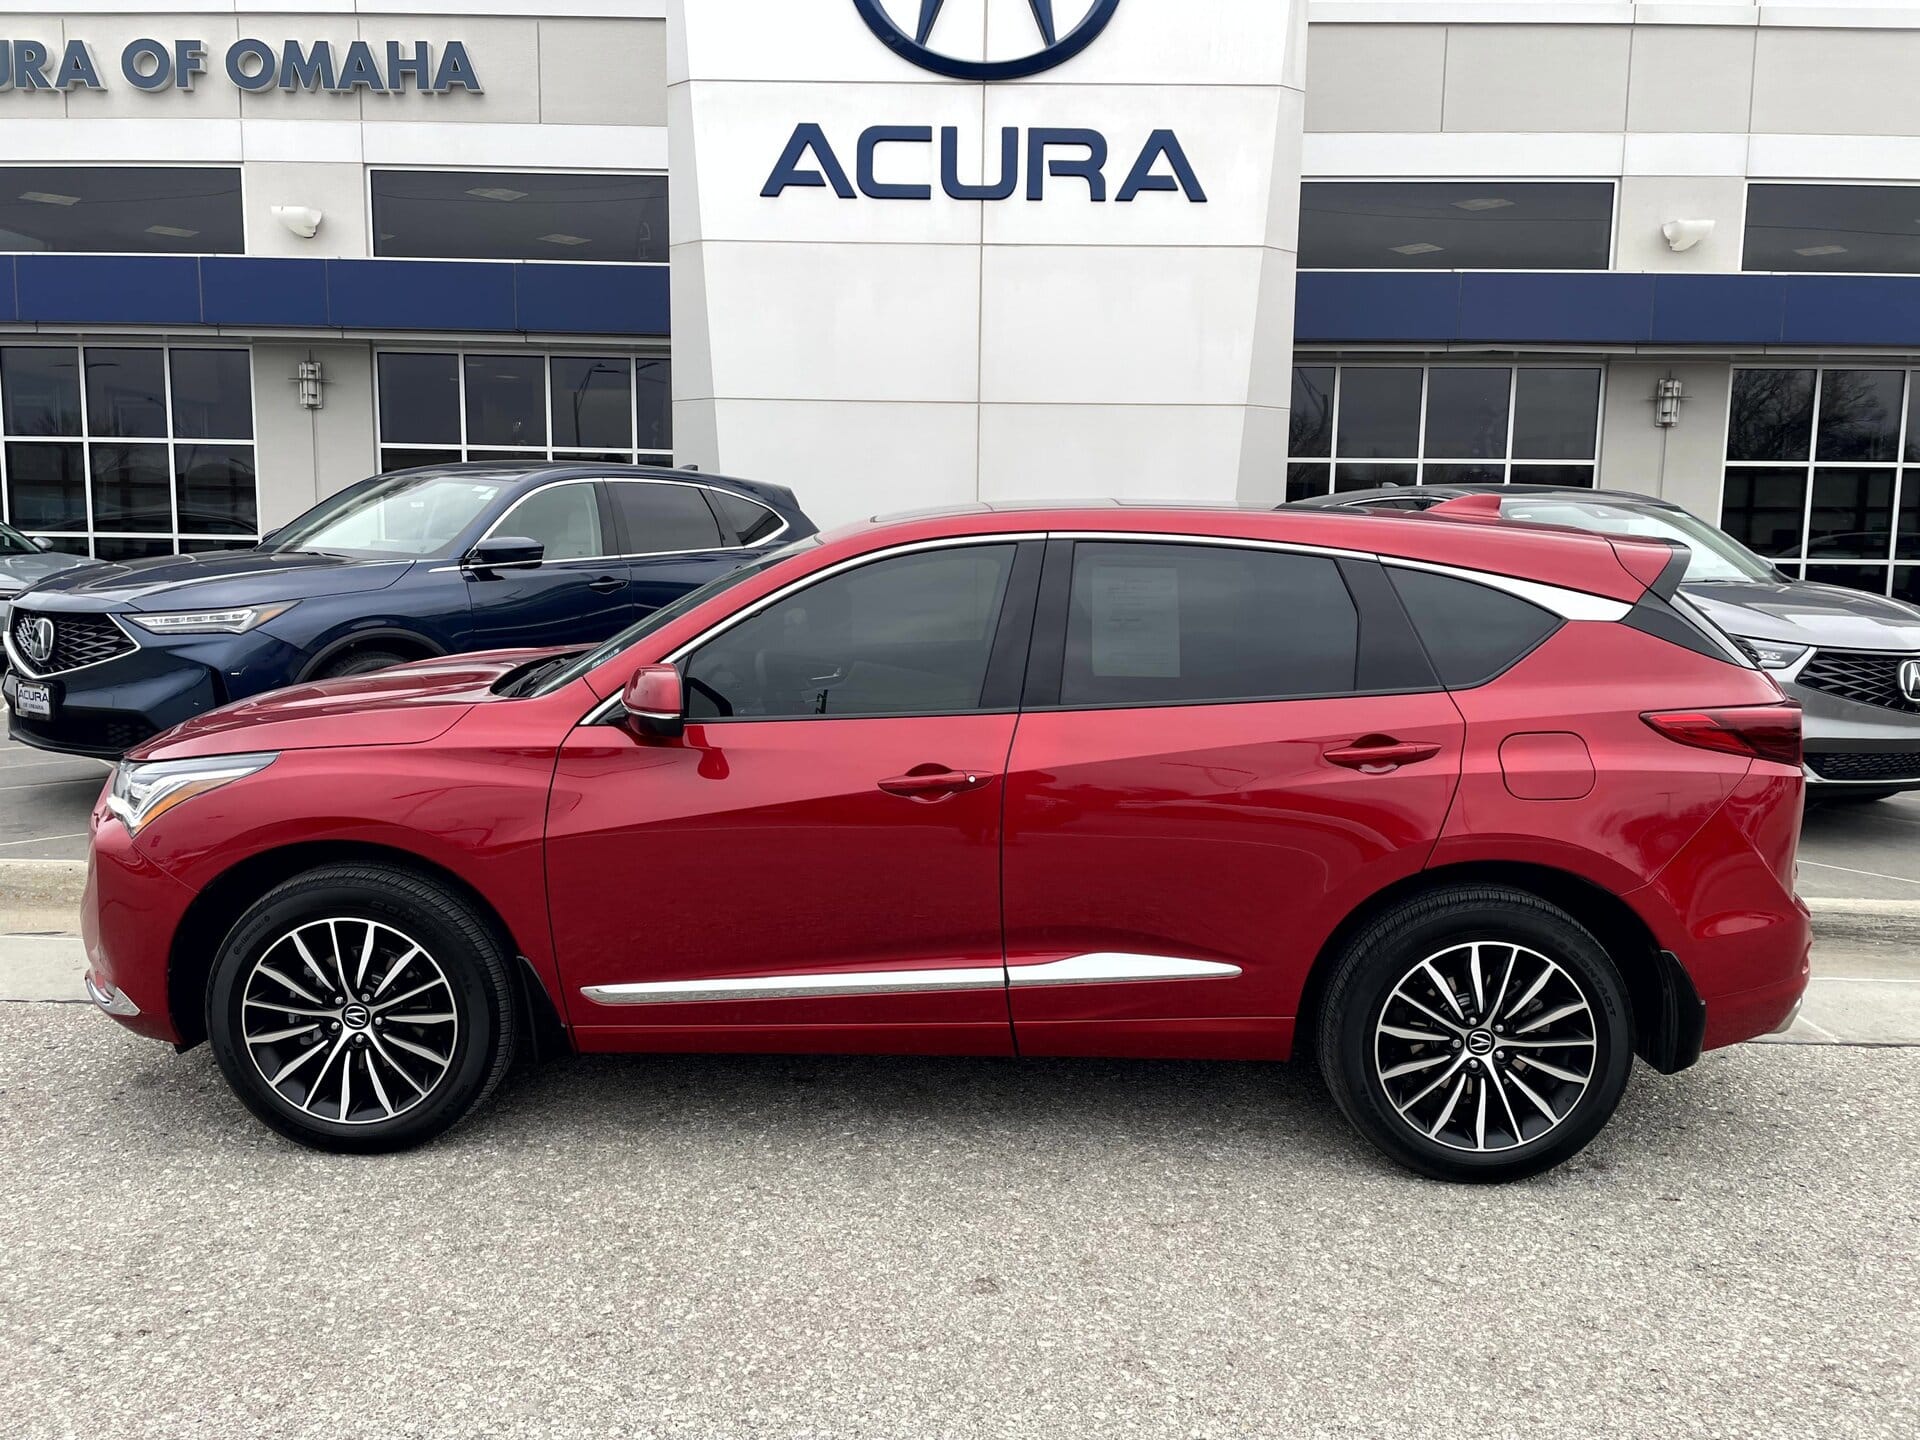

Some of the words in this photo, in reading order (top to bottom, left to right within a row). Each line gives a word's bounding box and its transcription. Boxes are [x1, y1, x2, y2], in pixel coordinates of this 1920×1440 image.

[0, 39, 105, 90] RA
[120, 37, 207, 91] OF
[225, 38, 483, 94] OMAHA
[759, 122, 1208, 203] ACURA
[18, 689, 49, 702] ACURA
